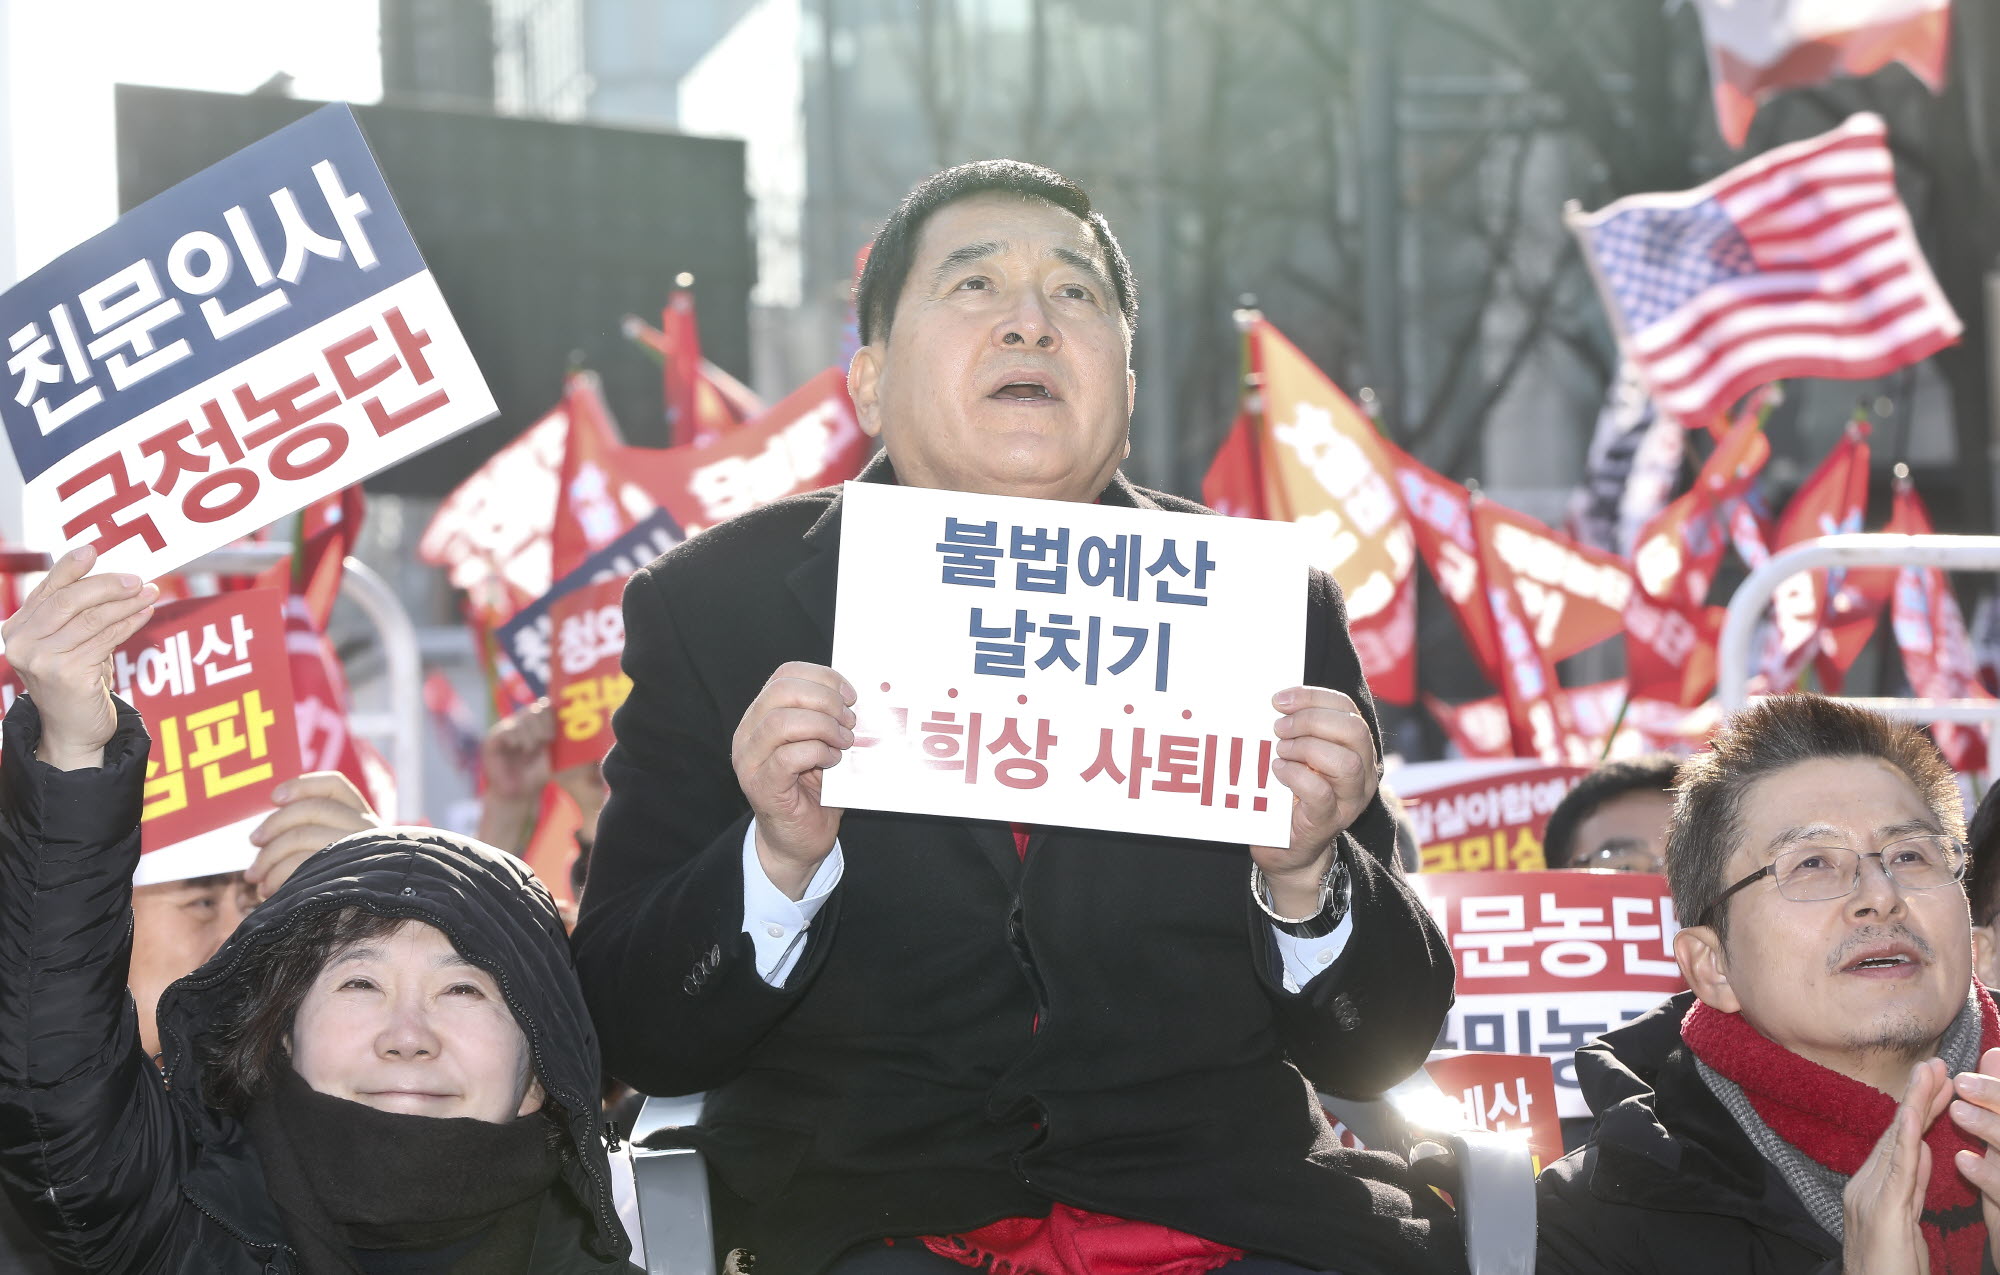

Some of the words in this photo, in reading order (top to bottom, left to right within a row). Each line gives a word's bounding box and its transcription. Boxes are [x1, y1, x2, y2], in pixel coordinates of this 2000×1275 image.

[7, 158, 380, 437] 친문인사
[56, 305, 451, 557] 국정농단
[936, 516, 1216, 606] 불법예산
[969, 607, 1171, 692] 날치기
[852, 706, 1058, 790] 희상
[1080, 726, 1272, 812] 사퇴!!
[1429, 892, 1685, 979] 문농단
